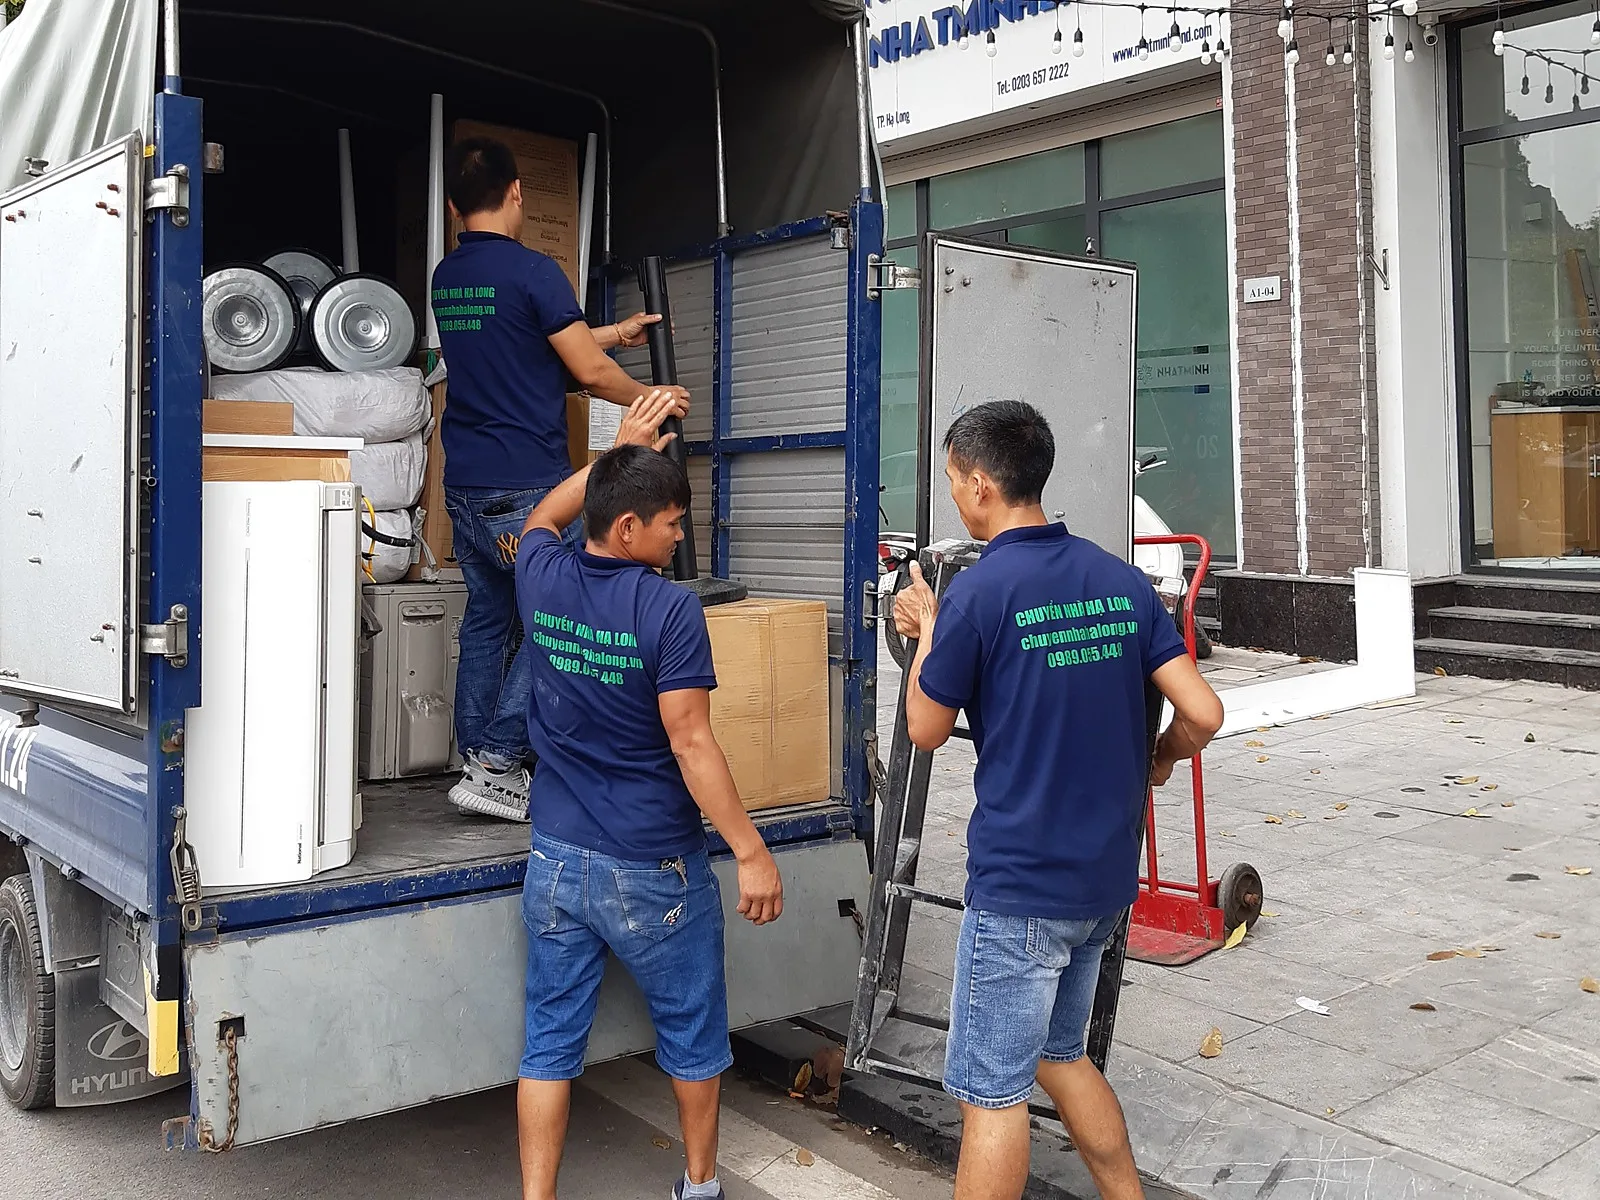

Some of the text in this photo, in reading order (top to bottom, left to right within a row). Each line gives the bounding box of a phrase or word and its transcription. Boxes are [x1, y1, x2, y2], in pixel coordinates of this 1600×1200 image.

[1011, 73, 1031, 91] 0203
[1032, 68, 1047, 86] 657
[1048, 62, 1070, 81] 2222
[475, 286, 496, 298] LONG
[1249, 286, 1275, 298] A1-04
[1157, 363, 1210, 377] NHATMINH
[1578, 373, 1591, 381] OF
[1521, 389, 1531, 397] IS
[1567, 388, 1592, 397] YOUR
[1085, 599, 1105, 617] HẠ
[1106, 596, 1134, 612] LON
[596, 630, 612, 647] HẠ
[71, 1066, 149, 1094] HYUN
